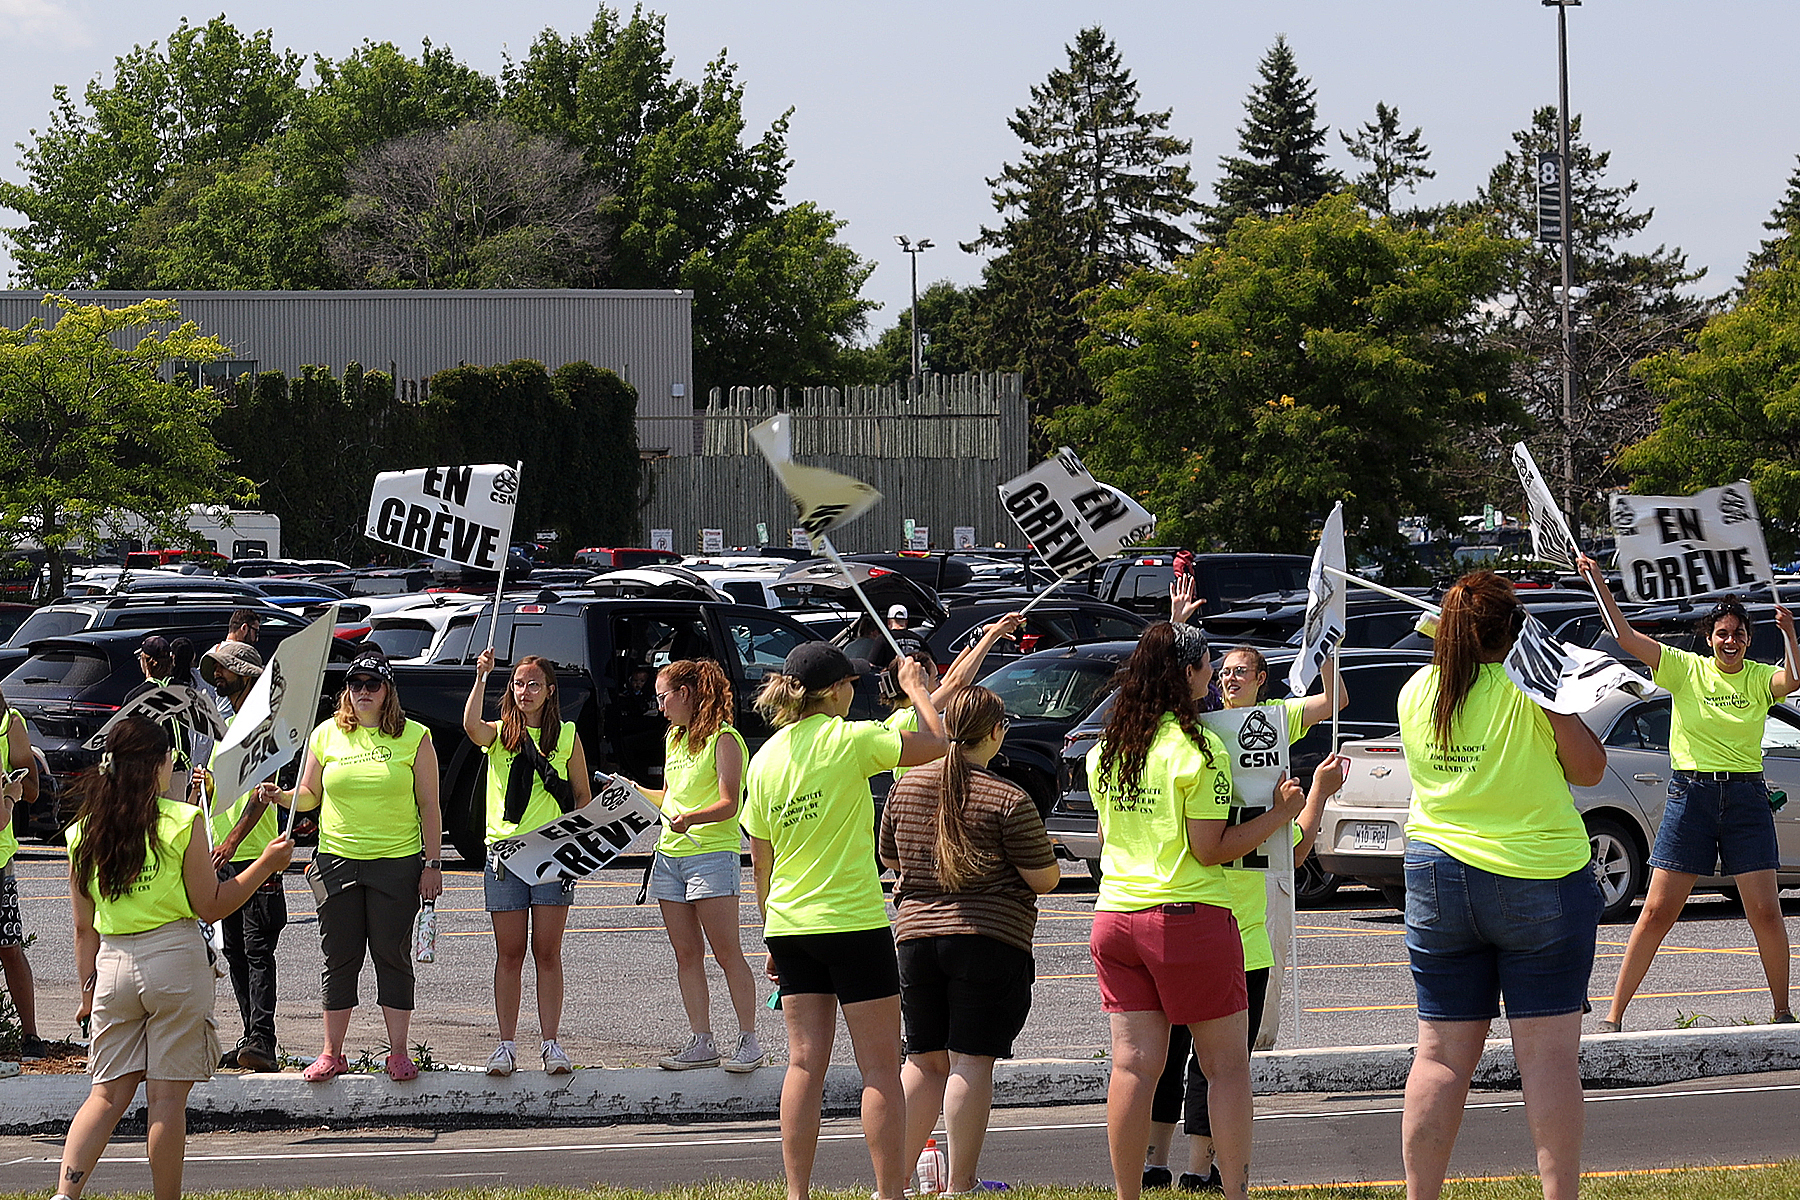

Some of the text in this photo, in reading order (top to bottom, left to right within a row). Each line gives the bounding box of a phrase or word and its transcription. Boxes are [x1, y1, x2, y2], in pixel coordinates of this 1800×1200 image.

[423, 466, 473, 507] EN
[489, 492, 517, 505] CSN
[377, 498, 500, 569] GRÈVE
[1006, 482, 1100, 577] GRÈVE
[1655, 507, 1707, 544] EN
[1633, 544, 1757, 599] GRÈVE
[239, 734, 280, 787] CSN
[1239, 751, 1280, 768] CSN
[608, 790, 631, 811] CSN
[1215, 795, 1231, 805] CSN
[538, 814, 595, 841] EN
[499, 841, 527, 861] CSN
